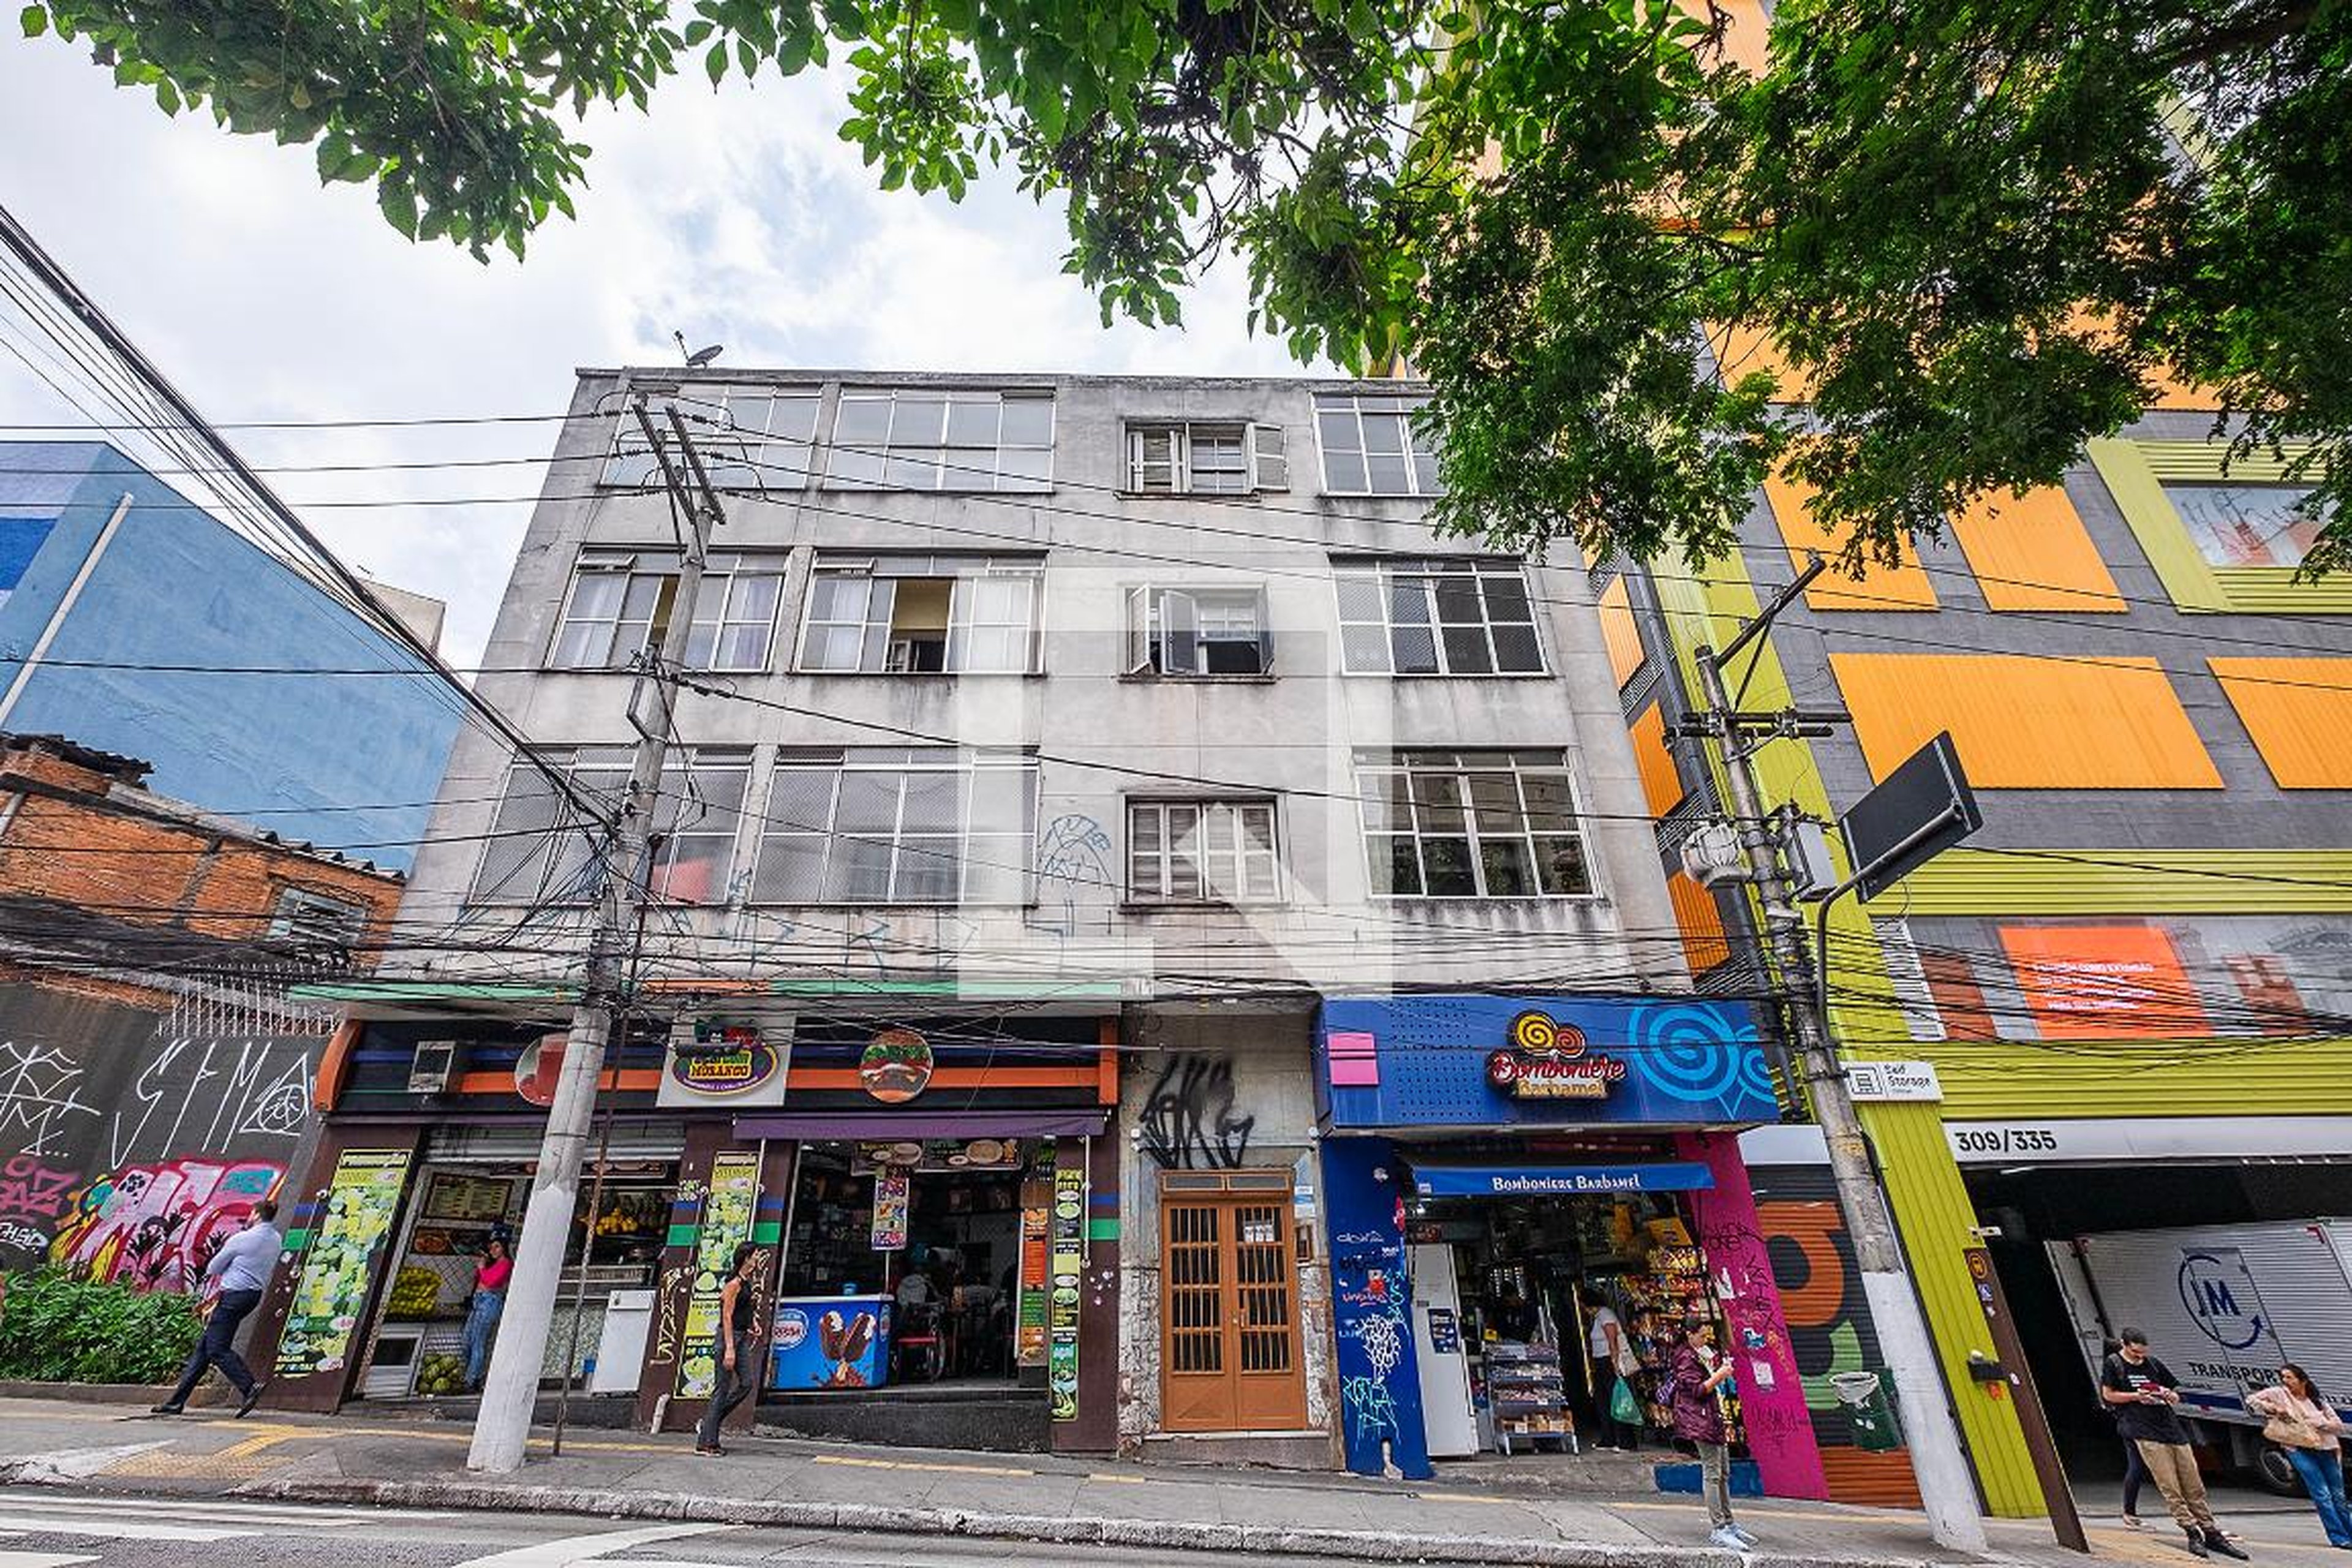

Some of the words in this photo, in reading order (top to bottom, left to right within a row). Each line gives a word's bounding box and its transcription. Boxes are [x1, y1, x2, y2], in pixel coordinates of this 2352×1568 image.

[1884, 1063, 1906, 1074] Self
[1888, 1076, 1932, 1088] Storage
[1954, 1128, 2057, 1153] 309/335
